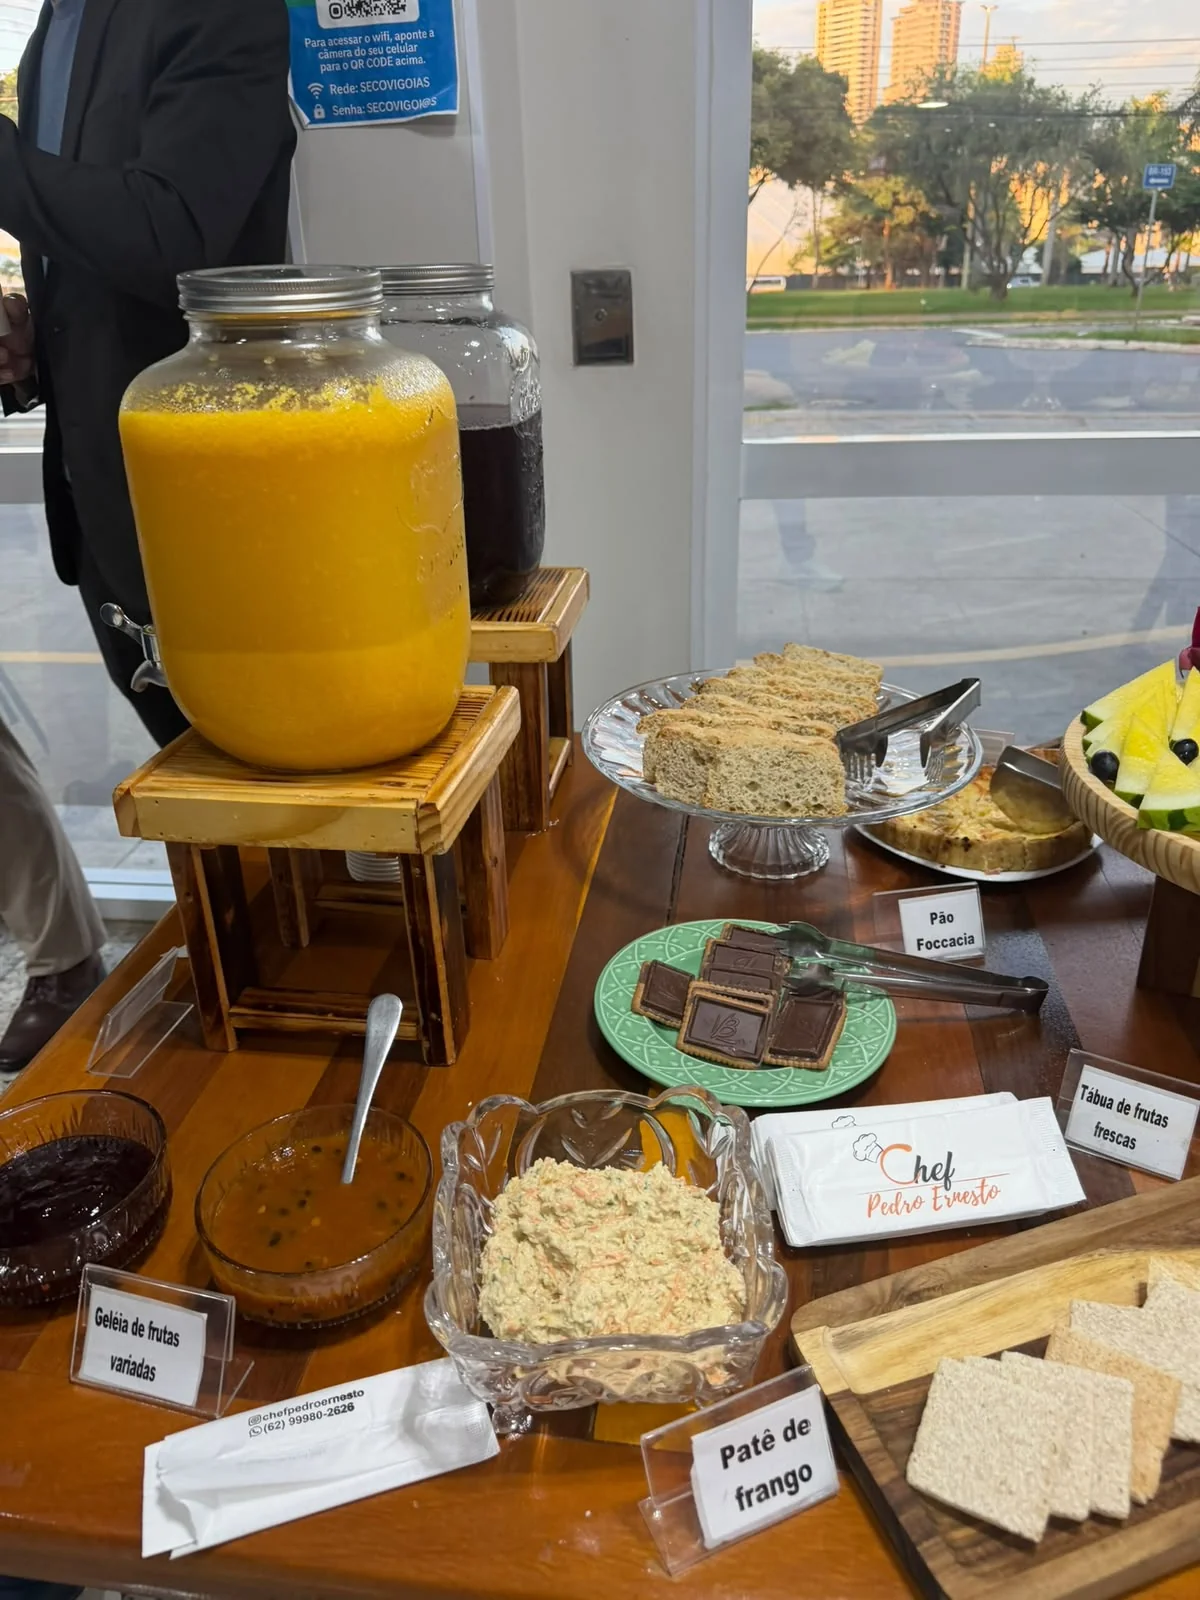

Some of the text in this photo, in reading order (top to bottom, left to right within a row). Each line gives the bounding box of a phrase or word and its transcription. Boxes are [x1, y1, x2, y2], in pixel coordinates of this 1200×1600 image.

[304, 29, 435, 48] Para acessar o wifi, aponte a
[318, 43, 418, 60] câmera do seu celular
[320, 56, 426, 74] para o QR CODE acima.
[329, 76, 430, 95] Rede: SECOVIGOIAS
[332, 104, 365, 116] Senha:
[930, 911, 954, 925] Pão
[916, 932, 975, 951] Foccacia
[1080, 1084, 1169, 1128] Tábua de frutas
[1093, 1121, 1137, 1150] frescas
[880, 1143, 956, 1191] Chef
[867, 1178, 1002, 1218] Pedro Ernesto
[94, 1306, 180, 1347] Geléia de frutas
[110, 1354, 156, 1382] variadas
[263, 1402, 355, 1434] (62) 99980-2626
[720, 1418, 811, 1470] Patê de
[735, 1463, 813, 1512] frango
